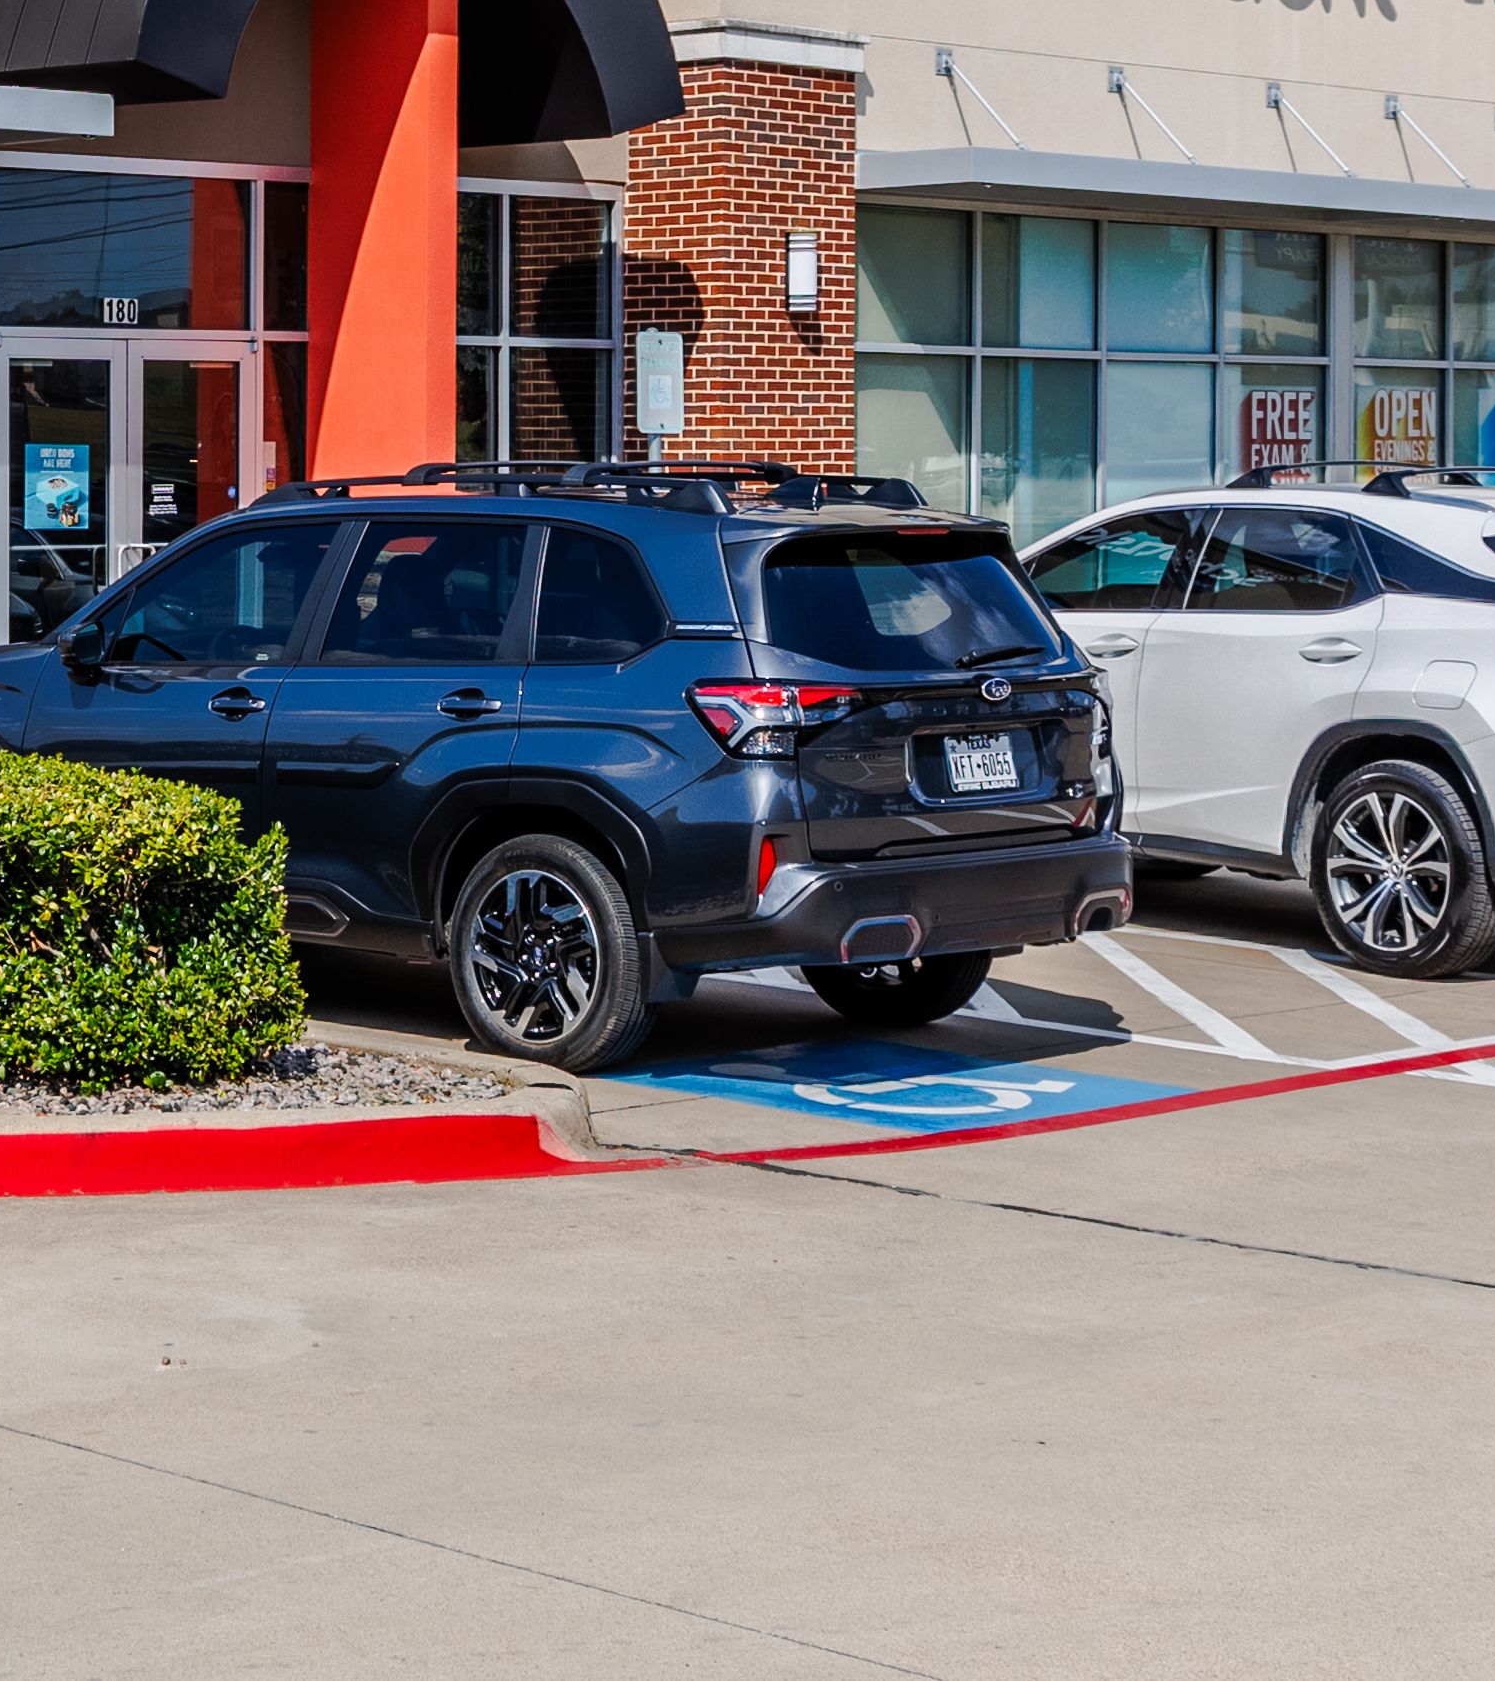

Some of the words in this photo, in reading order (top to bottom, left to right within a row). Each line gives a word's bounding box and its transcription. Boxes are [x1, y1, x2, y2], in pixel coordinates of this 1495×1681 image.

[106, 298, 137, 323] 180
[1251, 390, 1313, 440] FREE
[1374, 389, 1437, 438] OPEN
[1374, 439, 1425, 462] EVENINGS
[1427, 440, 1436, 462] &
